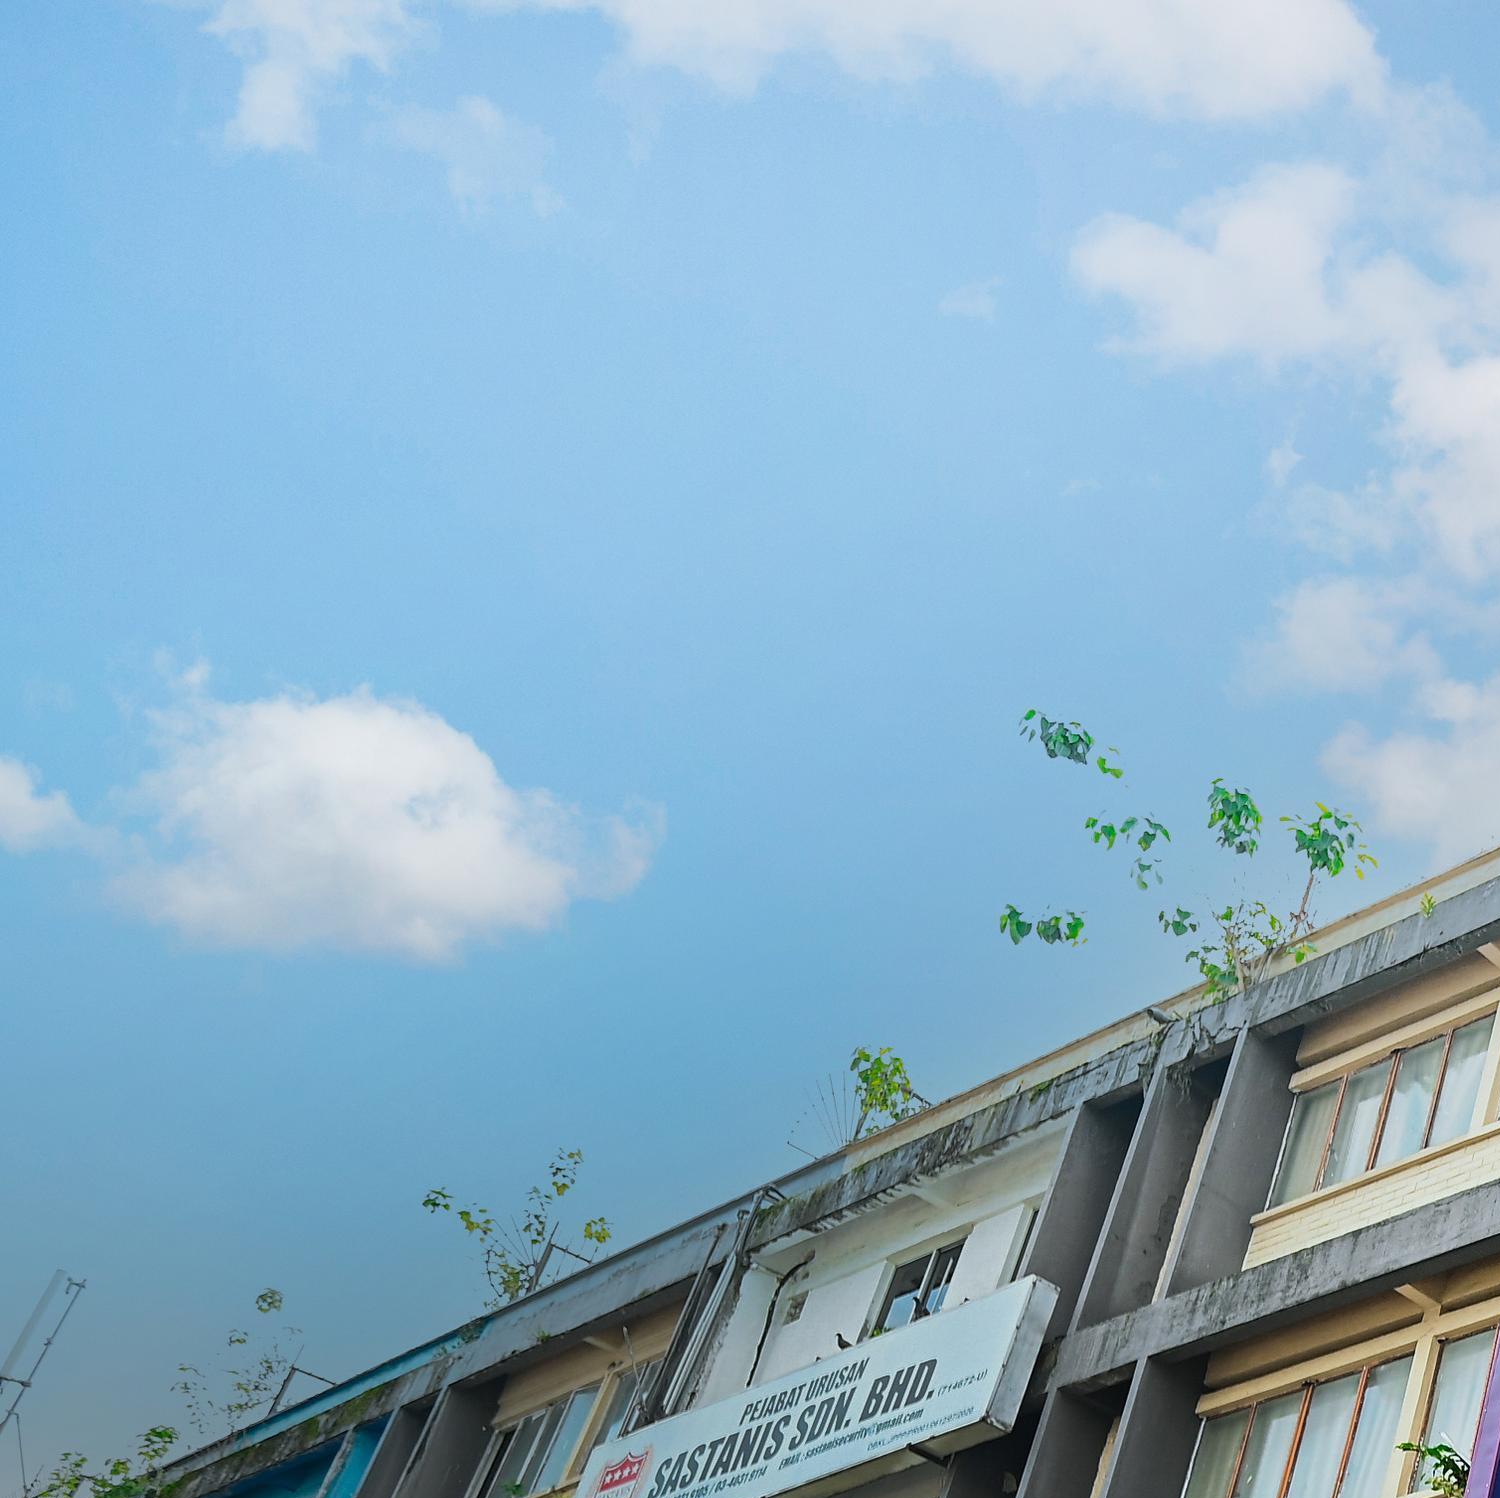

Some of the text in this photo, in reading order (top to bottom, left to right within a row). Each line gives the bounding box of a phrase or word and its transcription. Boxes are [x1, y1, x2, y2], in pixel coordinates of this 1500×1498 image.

[739, 1357, 870, 1426] PEJABAT URUSAN
[788, 1387, 856, 1451] SDN.
[858, 1358, 938, 1423] BHD.
